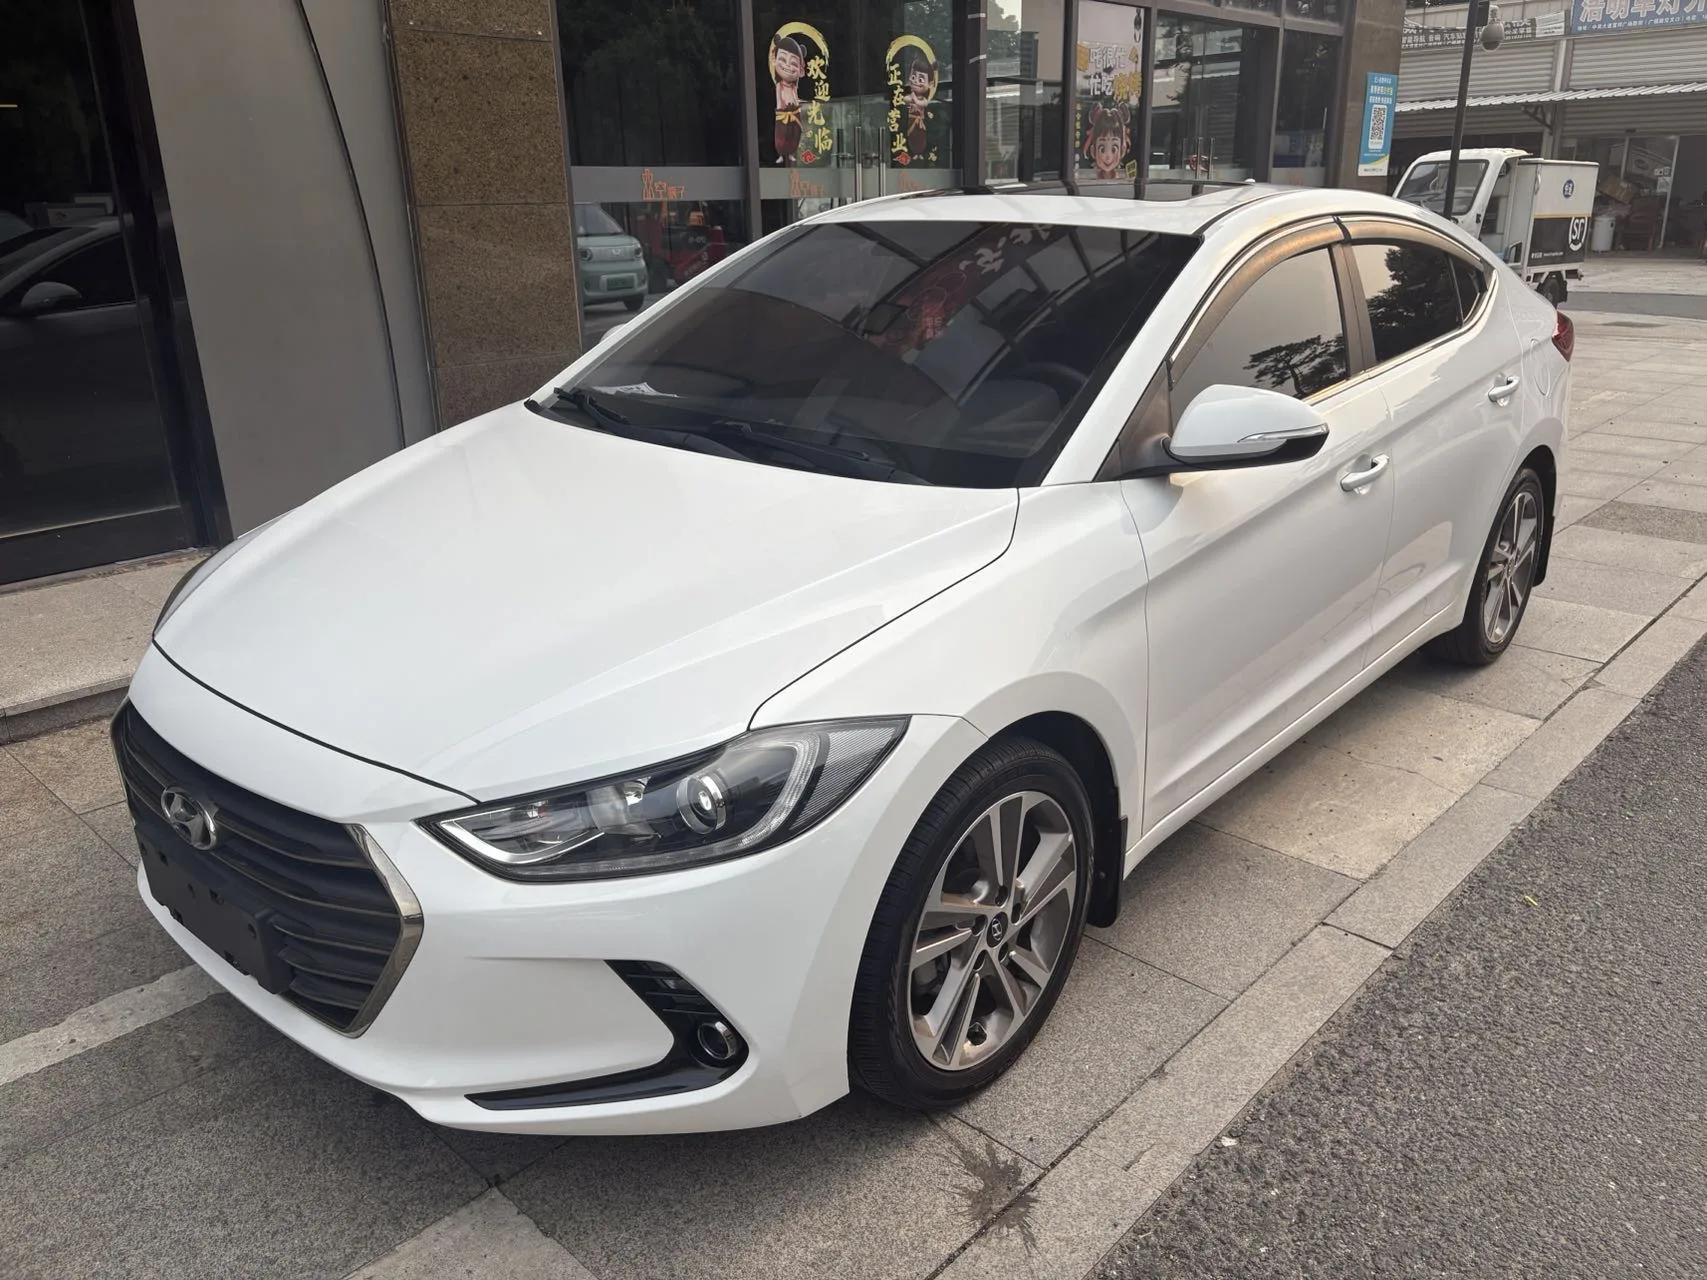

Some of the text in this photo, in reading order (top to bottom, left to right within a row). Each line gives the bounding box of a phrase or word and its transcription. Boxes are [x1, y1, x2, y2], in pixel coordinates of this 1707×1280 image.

[807, 55, 833, 153] 欢迎光临
[886, 63, 909, 153] 正在营业
